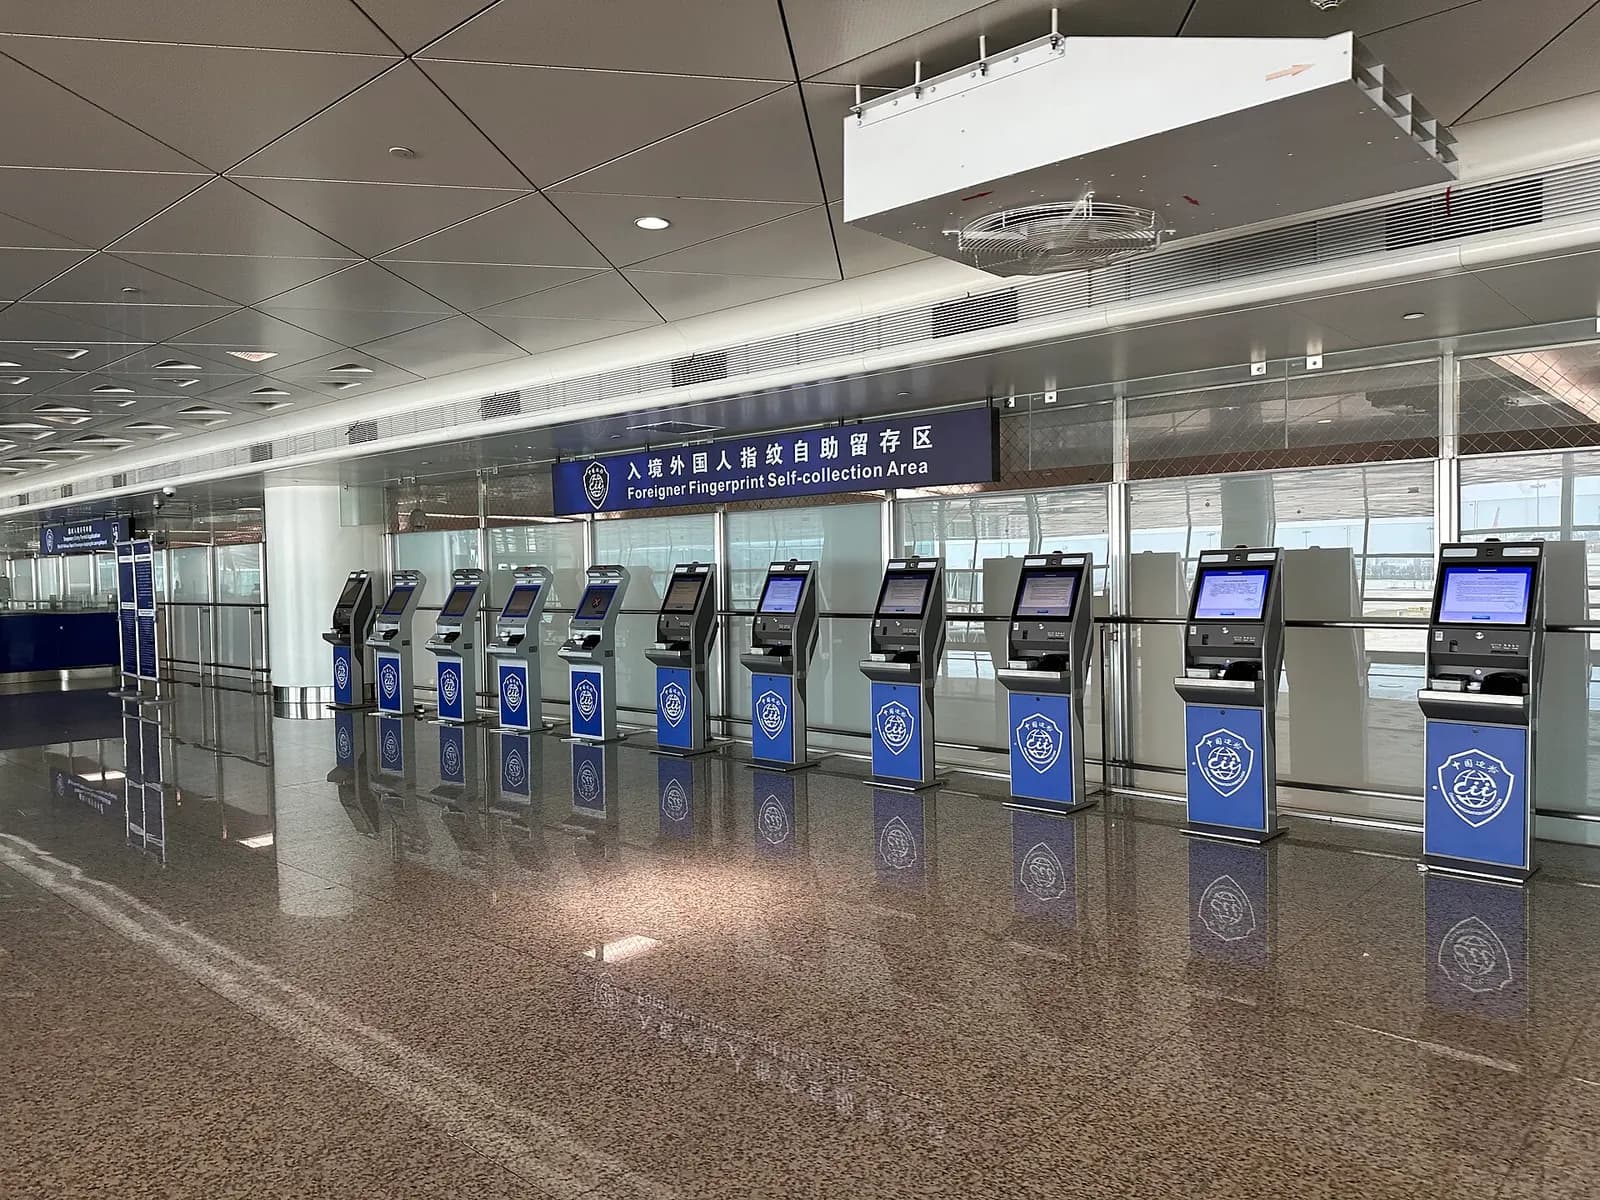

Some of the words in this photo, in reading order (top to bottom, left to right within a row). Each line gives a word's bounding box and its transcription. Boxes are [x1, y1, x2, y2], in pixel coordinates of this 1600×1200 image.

[626, 424, 934, 481] 入境外国人指纹自助留存区
[627, 484, 687, 500] Foreigner
[688, 474, 765, 496] Fingerprint
[767, 463, 883, 488] Self-collection
[886, 460, 929, 477] Area
